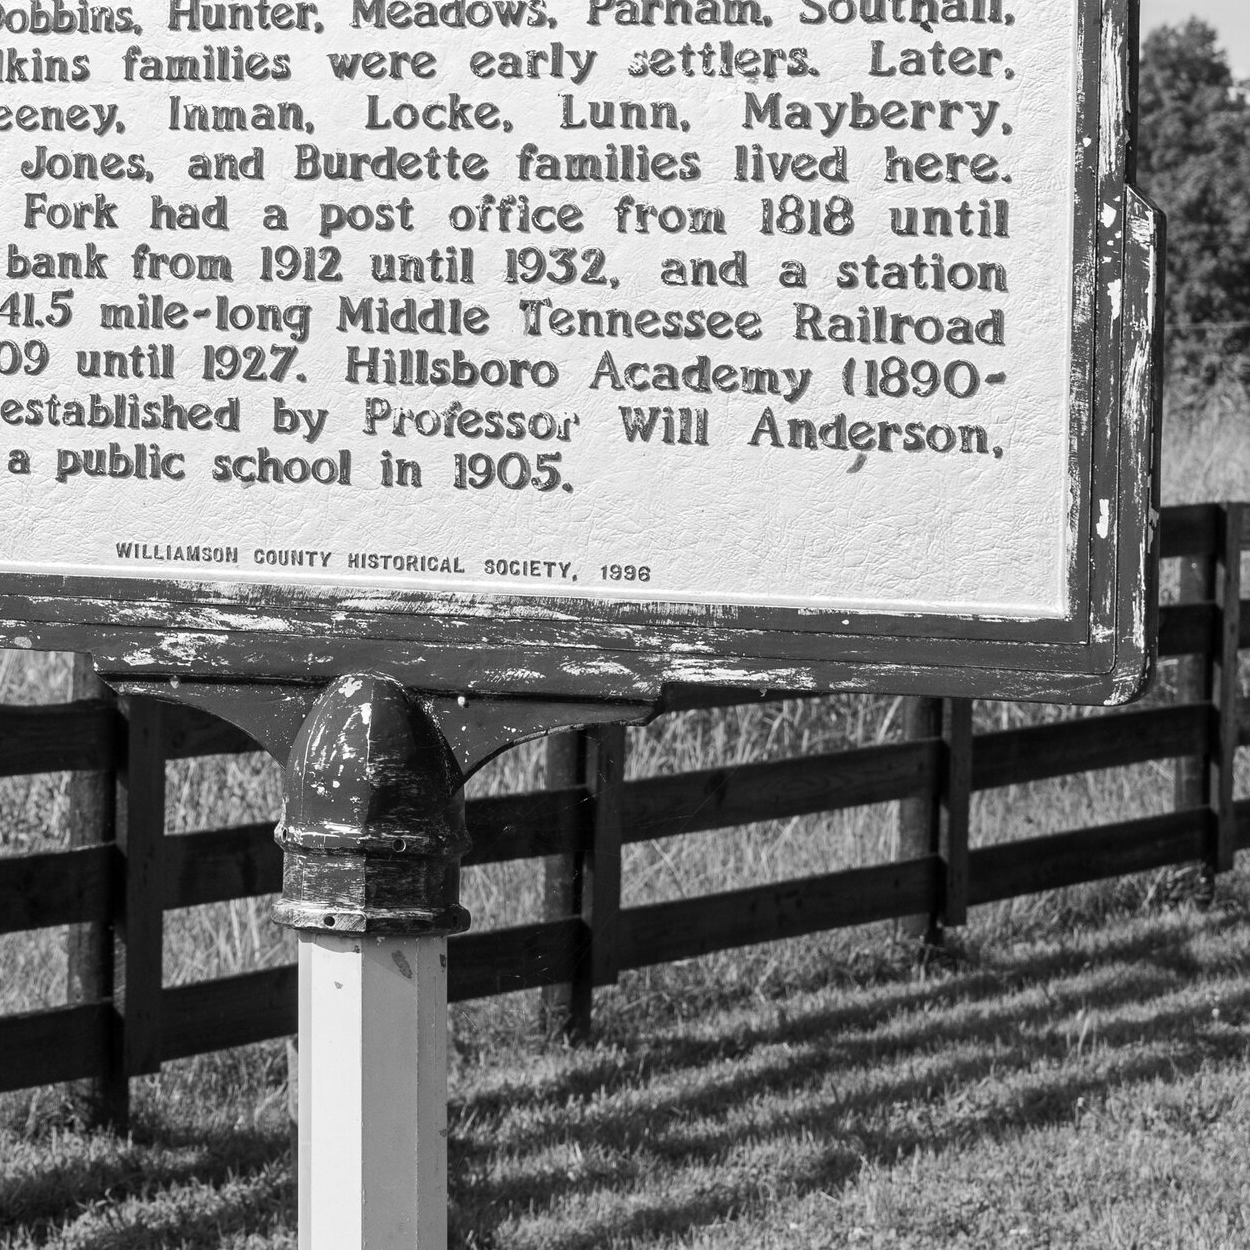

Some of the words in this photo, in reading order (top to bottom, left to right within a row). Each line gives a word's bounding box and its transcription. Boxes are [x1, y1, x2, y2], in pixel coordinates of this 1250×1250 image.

[122, 45, 291, 81] families
[327, 52, 436, 80] were
[470, 42, 598, 84] early
[628, 40, 820, 79] settlers.
[869, 40, 1015, 80] Later,
[169, 96, 314, 134] Inman,
[365, 93, 513, 133] Locke,
[560, 94, 690, 132] Lunn,
[742, 92, 1012, 138] Mayberry,
[21, 146, 153, 183] Jones,
[188, 147, 264, 180] and
[294, 144, 489, 181] Burdette
[516, 143, 701, 182] families
[734, 144, 849, 183] lived
[884, 146, 1012, 184] here.
[24, 193, 118, 229] Fork
[150, 196, 229, 231] had
[263, 205, 288, 231] a
[319, 197, 414, 239] post
[449, 194, 583, 233] office
[614, 196, 727, 234] from
[760, 194, 854, 236] 1818
[889, 199, 1009, 238] until
[6, 243, 108, 279] bank
[131, 244, 233, 282] from
[260, 246, 343, 282] 1912
[371, 246, 474, 284] until
[504, 247, 619, 289] 1932,
[661, 251, 748, 288] and
[779, 261, 807, 288] a
[837, 253, 1008, 292] station
[100, 293, 312, 343] mile-long
[336, 296, 489, 335] Middle
[519, 297, 762, 340] Tennessee
[793, 303, 1005, 346] Railroad
[76, 344, 174, 379] until
[202, 344, 306, 383] 1927.
[345, 346, 559, 388] Hillsboro
[589, 350, 812, 403] Academy
[842, 356, 1006, 398] (1890-
[1, 393, 240, 432] established
[274, 397, 329, 444] by
[363, 398, 580, 442] Professor
[619, 406, 709, 446] Will
[747, 407, 1003, 458] Anderson,
[8, 450, 31, 474] a
[55, 443, 185, 483] public
[212, 447, 351, 485] school
[381, 450, 422, 488] in
[453, 452, 573, 493] 1905.
[116, 543, 237, 563] WILLIAMSON
[254, 549, 331, 567] COUNTY
[349, 553, 464, 573] HISTORICAL
[485, 560, 577, 581] SOCIETY,
